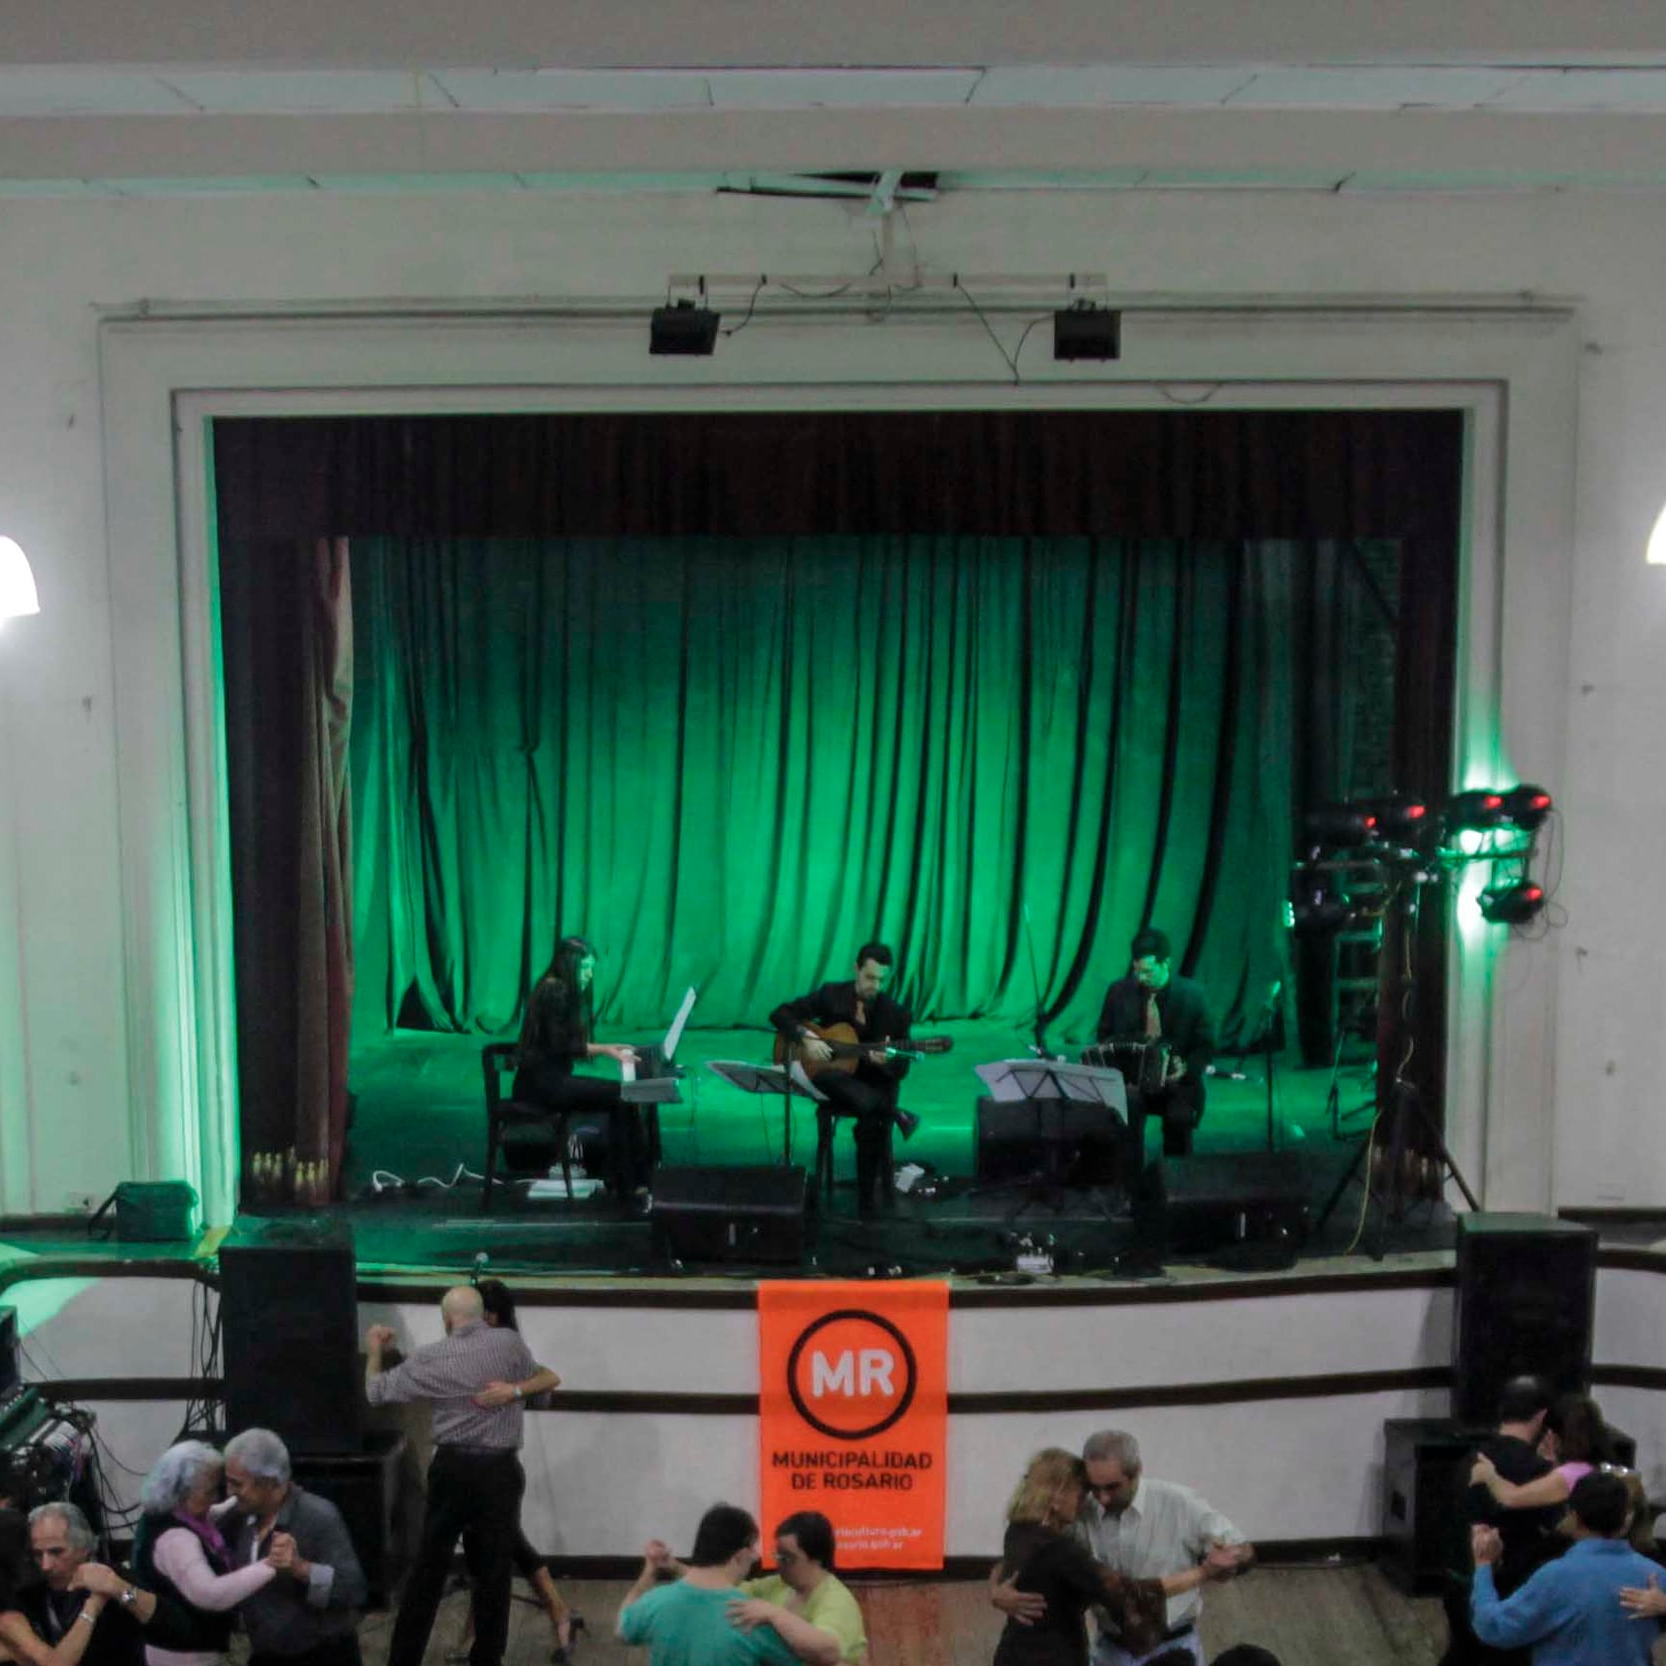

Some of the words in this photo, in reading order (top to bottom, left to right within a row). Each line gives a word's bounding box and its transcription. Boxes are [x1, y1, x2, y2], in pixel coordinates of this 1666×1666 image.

[812, 1348, 895, 1397] MR
[772, 1452, 933, 1469] MUNICIPALIDAD
[791, 1474, 817, 1490] DE
[823, 1474, 913, 1491] ROSARIO
